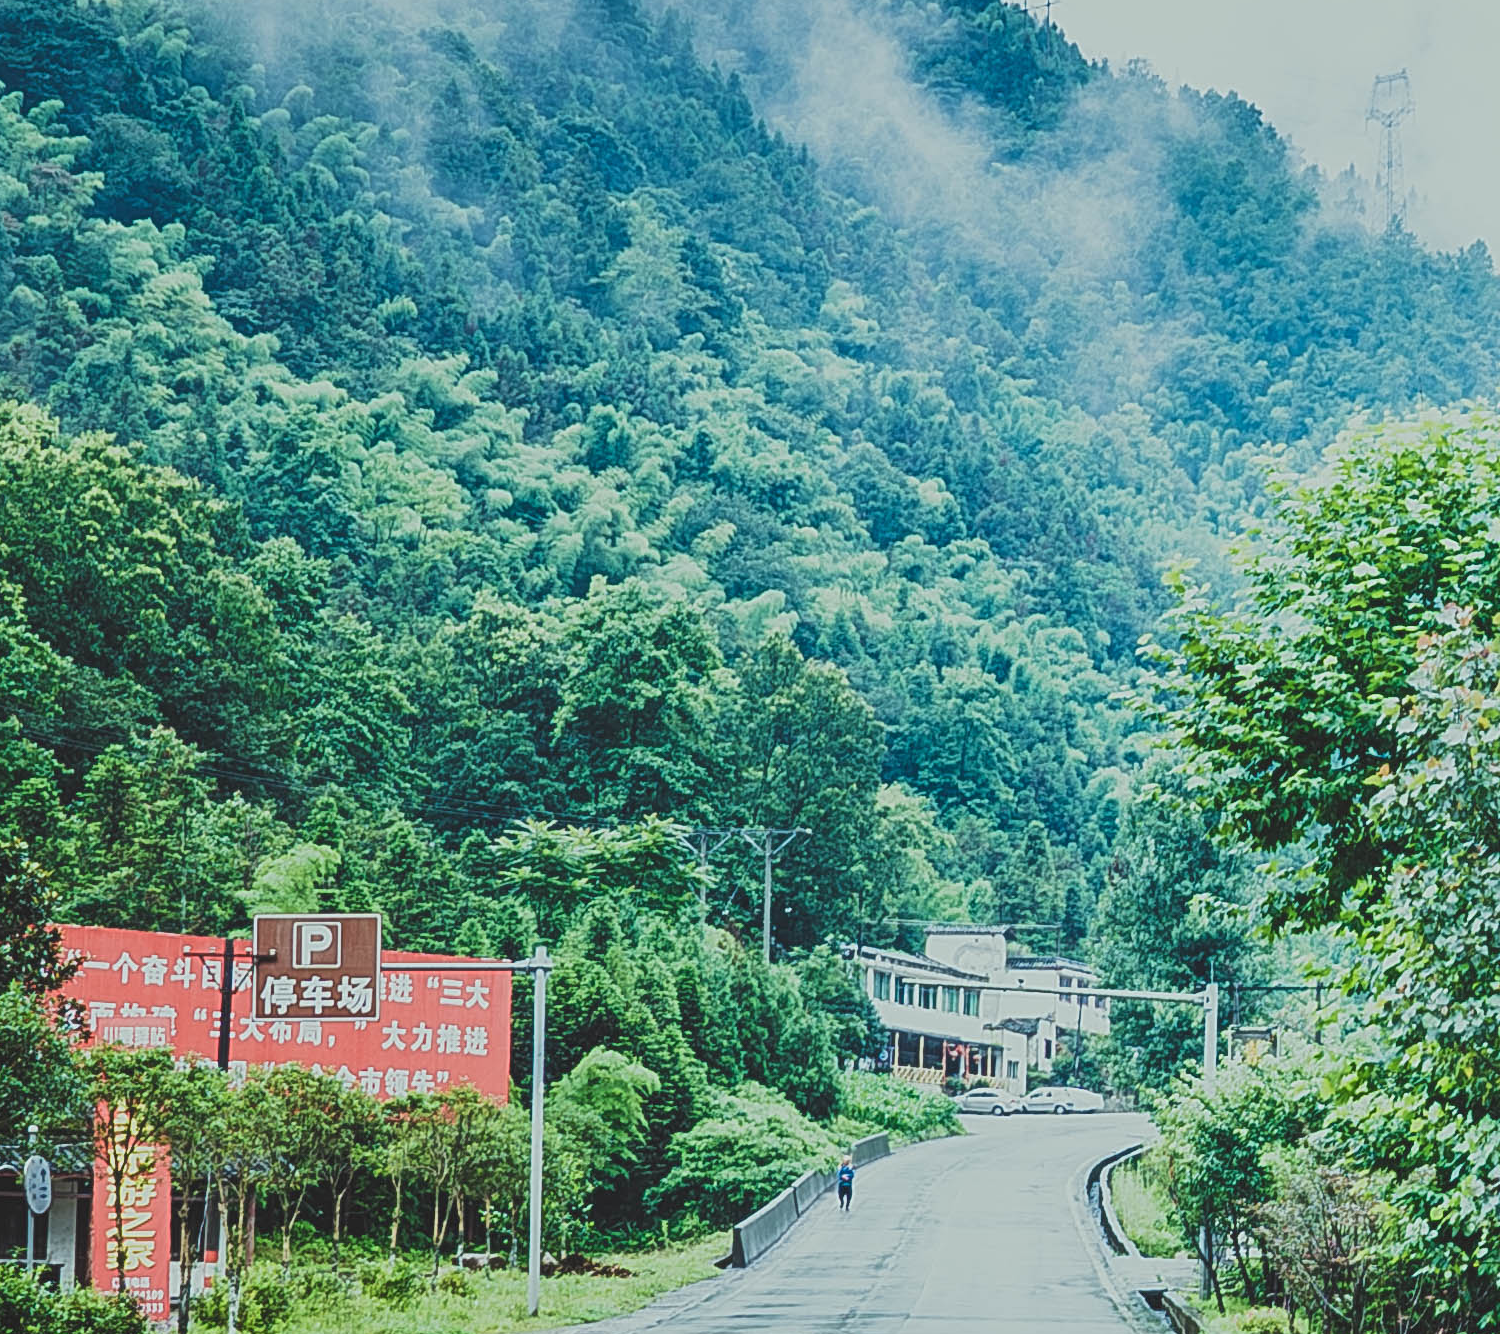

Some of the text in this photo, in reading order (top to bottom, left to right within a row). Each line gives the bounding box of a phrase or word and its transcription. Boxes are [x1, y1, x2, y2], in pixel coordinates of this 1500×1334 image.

[301, 925, 333, 965] P
[259, 975, 374, 1015] 停车场
